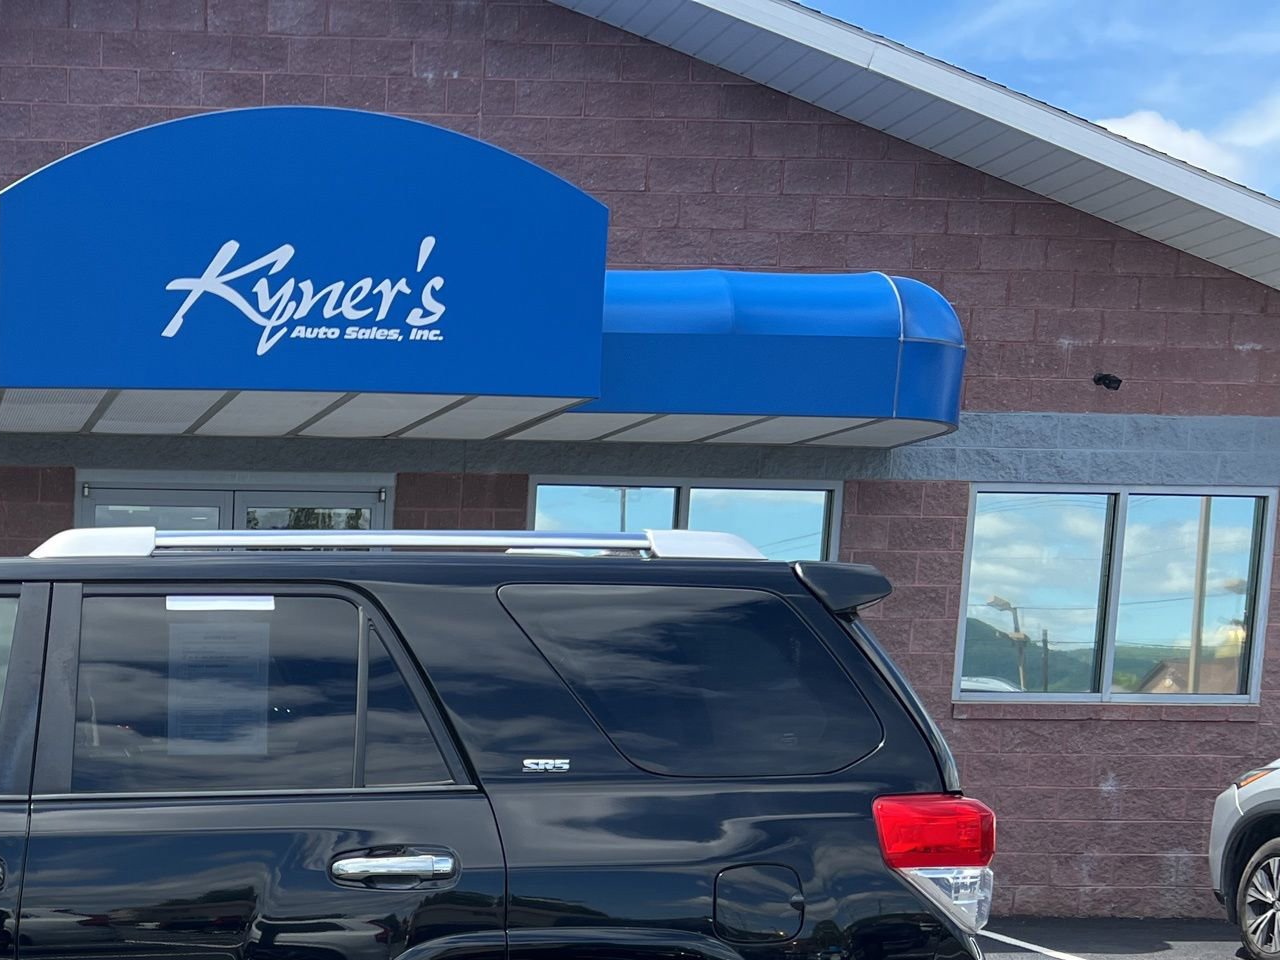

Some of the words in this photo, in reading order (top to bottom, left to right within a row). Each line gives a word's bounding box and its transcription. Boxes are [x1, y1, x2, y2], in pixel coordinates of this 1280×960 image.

[161, 236, 446, 356] Kyner's
[290, 325, 340, 340] Auto
[344, 326, 403, 342] Sales,
[409, 327, 444, 341] Inc.
[522, 758, 570, 771] SR5
